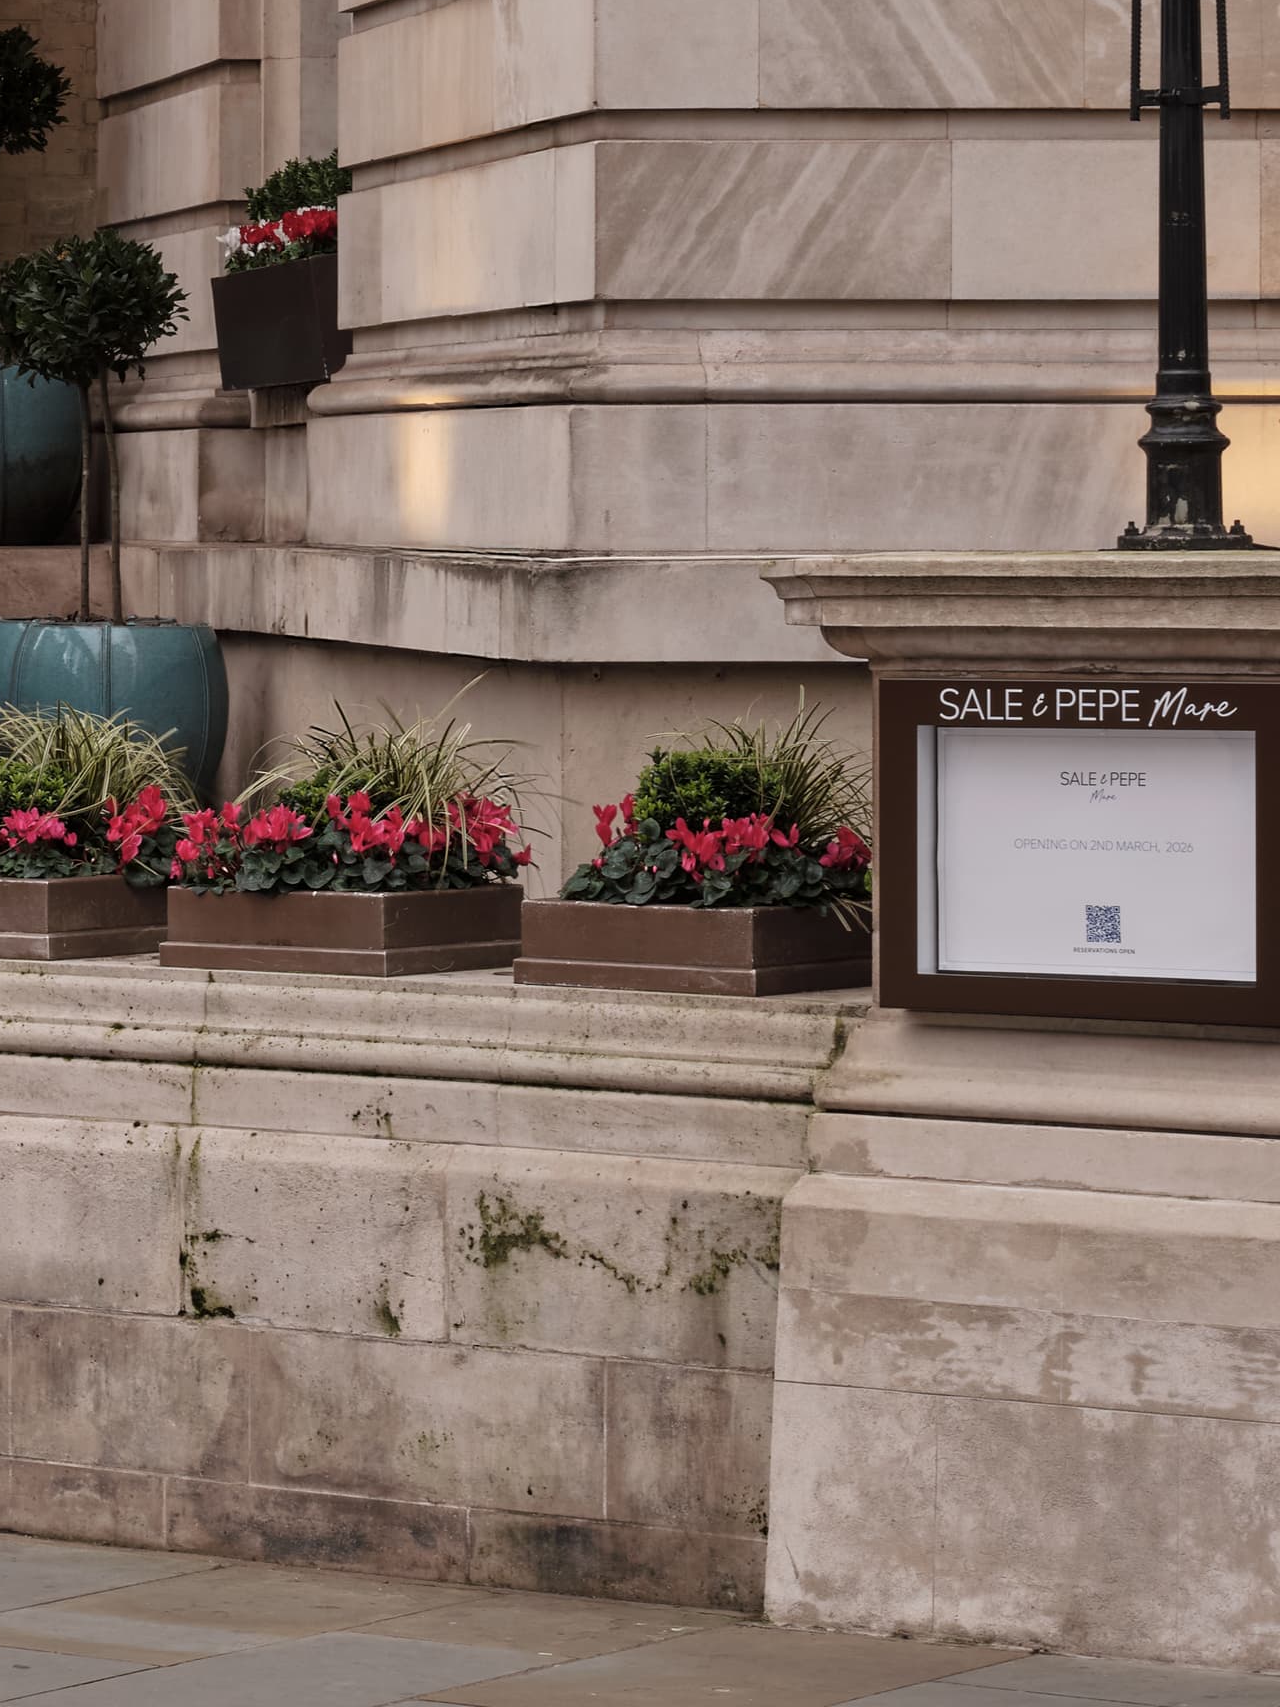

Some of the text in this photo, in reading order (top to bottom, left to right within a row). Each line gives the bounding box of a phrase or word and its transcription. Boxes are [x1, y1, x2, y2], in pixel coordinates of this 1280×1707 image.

[939, 687, 1238, 727] SALE & PEPE Mare
[1060, 771, 1097, 787] SALE
[1110, 772, 1147, 787] PEPE
[1089, 788, 1118, 803] Mare
[1013, 838, 1194, 853] OPENING ON 2ND MARCH, 2026
